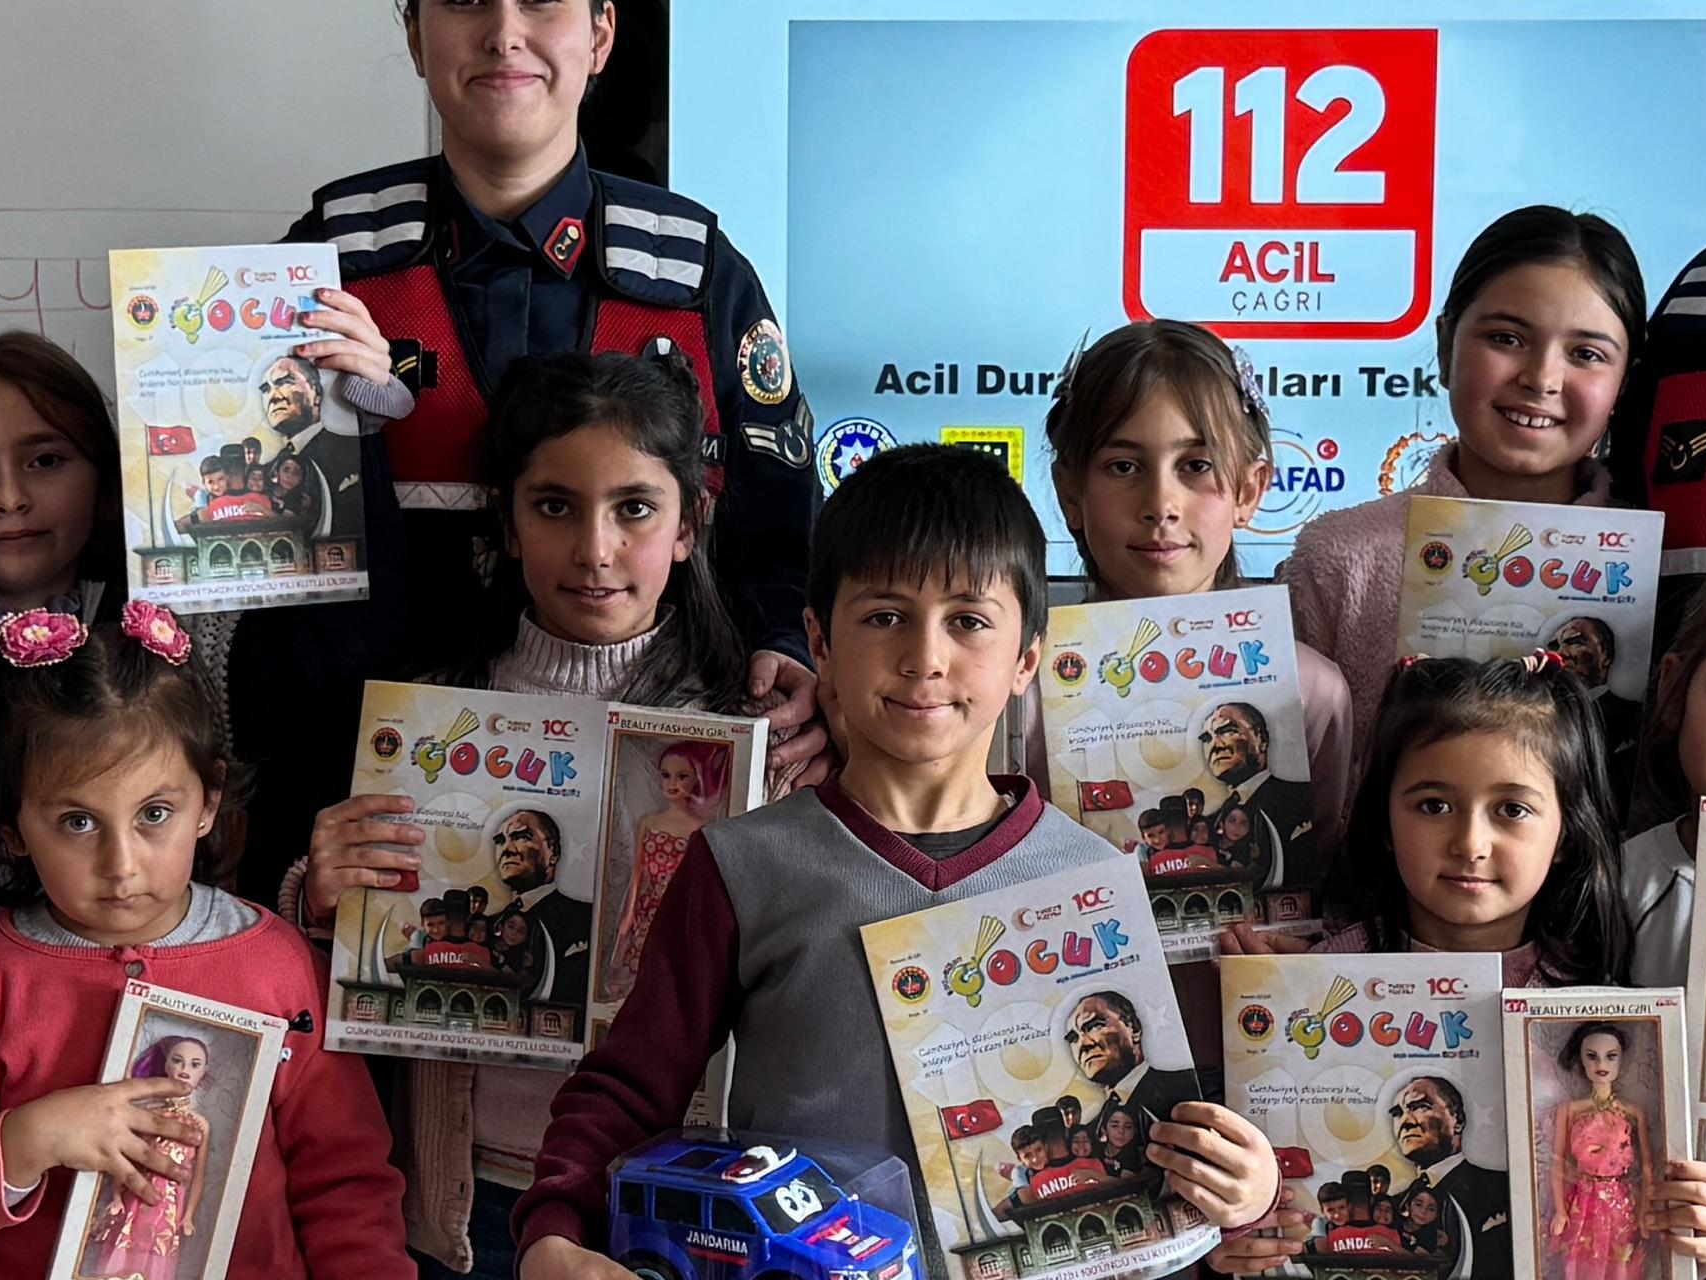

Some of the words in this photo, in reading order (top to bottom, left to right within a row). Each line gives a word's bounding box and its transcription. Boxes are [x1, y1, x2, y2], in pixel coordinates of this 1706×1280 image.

[1171, 64, 1387, 206] 112
[1219, 239, 1335, 284] ACİL
[1231, 289, 1323, 317] ÇAĞRI
[874, 363, 959, 396] Acil
[976, 364, 1063, 396] Dur
[1468, 556, 1633, 597] ÇOCUK
[1102, 639, 1270, 698] ÇOCUK
[417, 740, 577, 786] ÇOCUK
[950, 918, 1129, 1008] ÇOCUK
[149, 991, 188, 1013] BEAUTY
[191, 1003, 235, 1023] FASHION
[236, 1016, 260, 1031] GIRL
[1529, 1004, 1572, 1016] BEAUTY
[1574, 1004, 1627, 1016] FASHION
[1629, 1004, 1653, 1015] GIRL
[1292, 1010, 1473, 1060] ÇOCUK
[686, 1229, 749, 1255] JANDARMA
